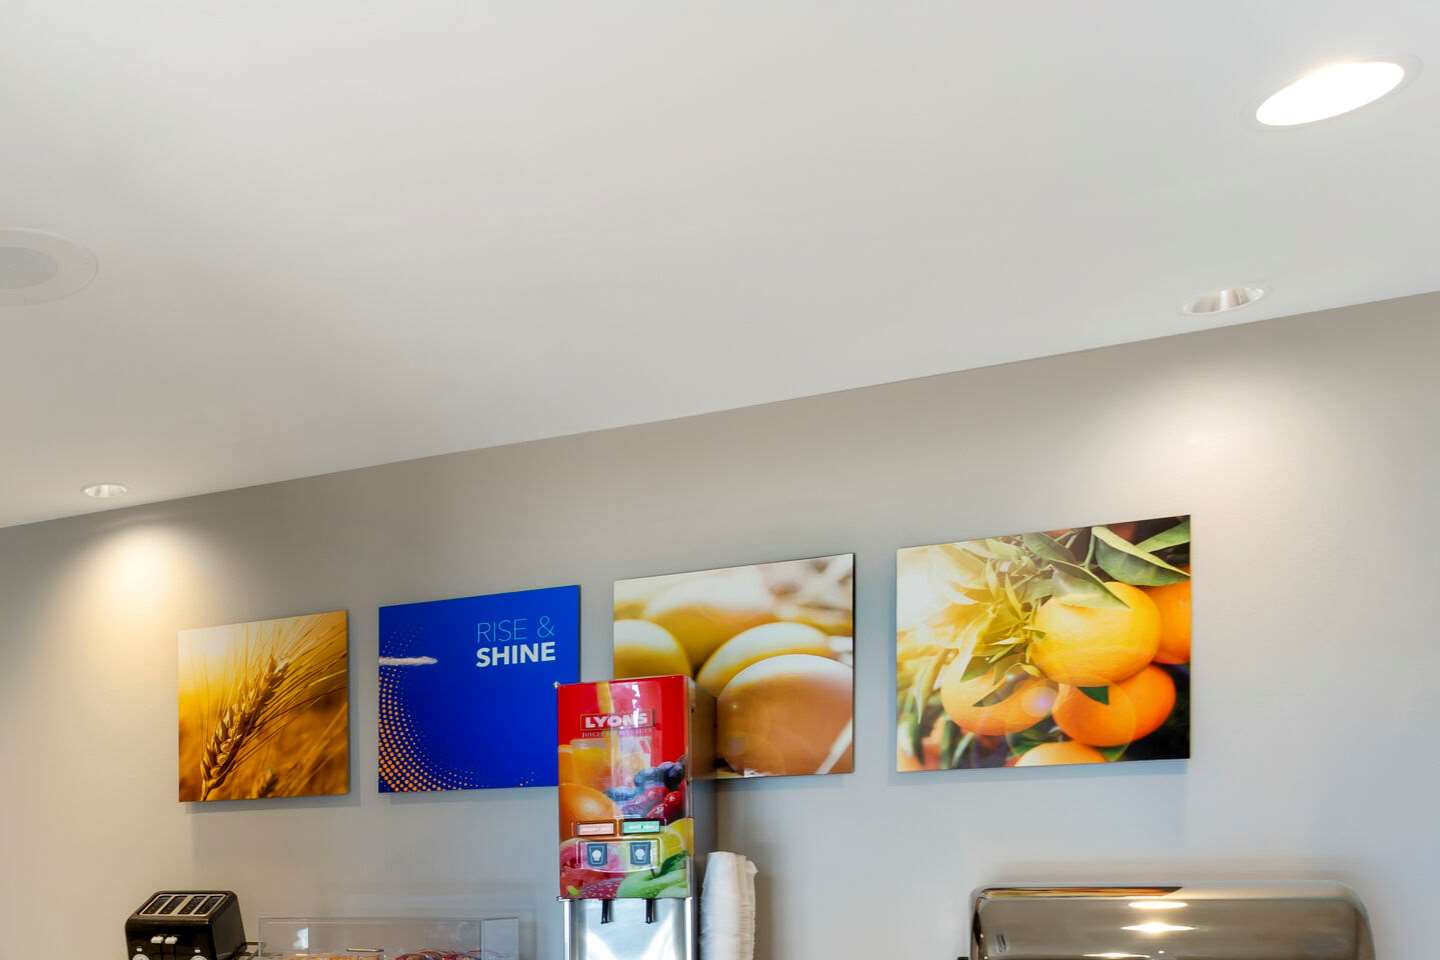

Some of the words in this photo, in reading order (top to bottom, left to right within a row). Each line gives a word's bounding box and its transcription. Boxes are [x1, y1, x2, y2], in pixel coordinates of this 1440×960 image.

[476, 618, 529, 643] RISE
[536, 615, 555, 639] &
[475, 641, 557, 667] SHINE
[585, 712, 648, 729] LYONS
